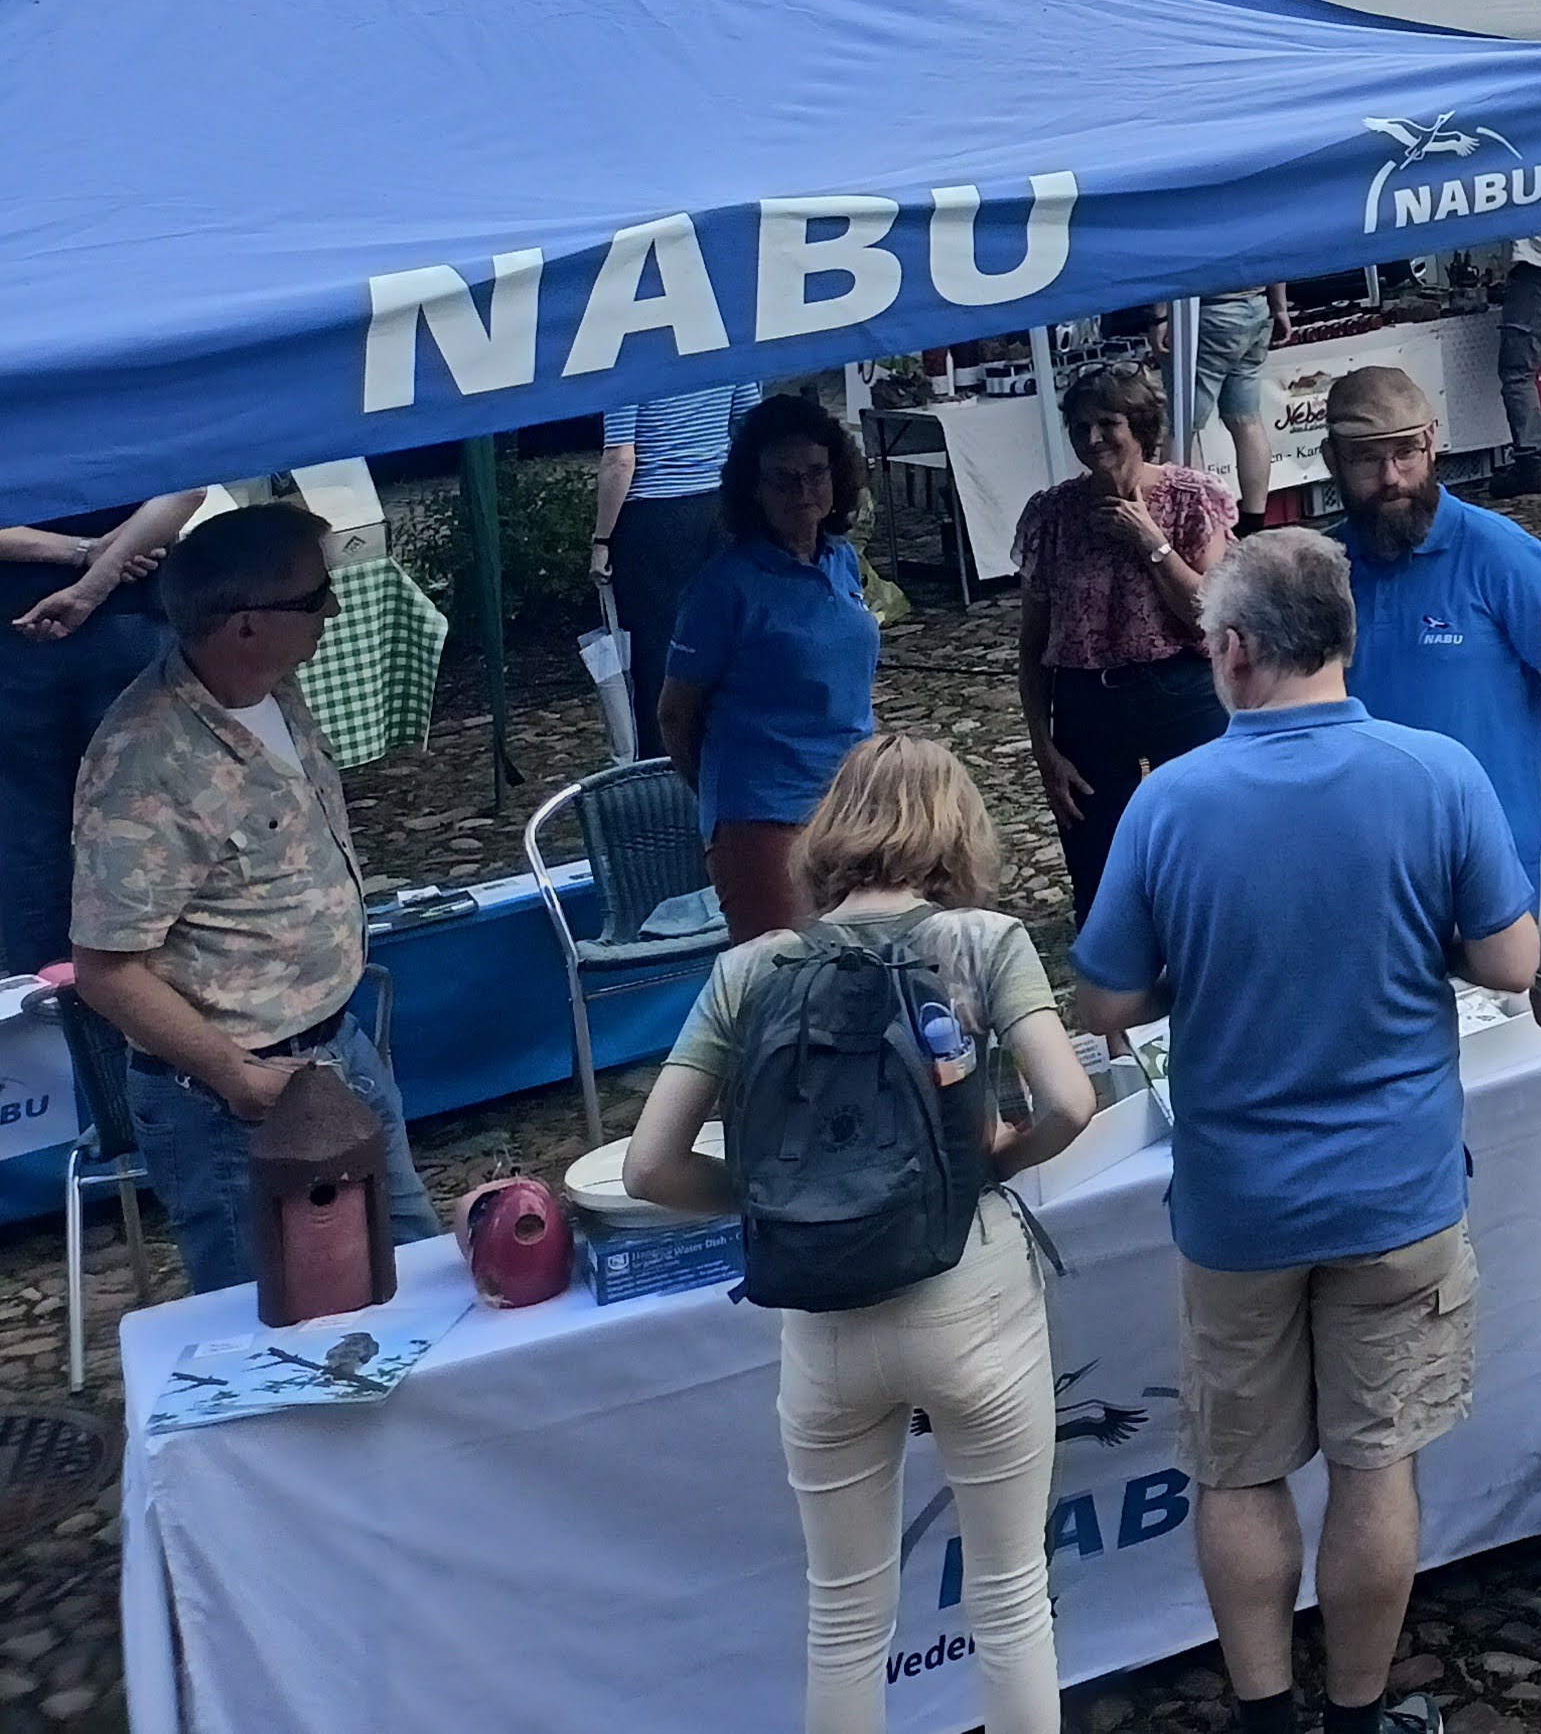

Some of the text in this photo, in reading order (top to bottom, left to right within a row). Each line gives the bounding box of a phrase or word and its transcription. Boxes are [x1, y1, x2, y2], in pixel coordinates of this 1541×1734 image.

[364, 170, 1077, 414] NABU
[1275, 401, 1327, 431] Nebe
[1424, 634, 1464, 645] NABU
[0, 1094, 49, 1126] BU
[705, 1235, 727, 1249] Dish
[938, 1467, 1191, 1610] AB
